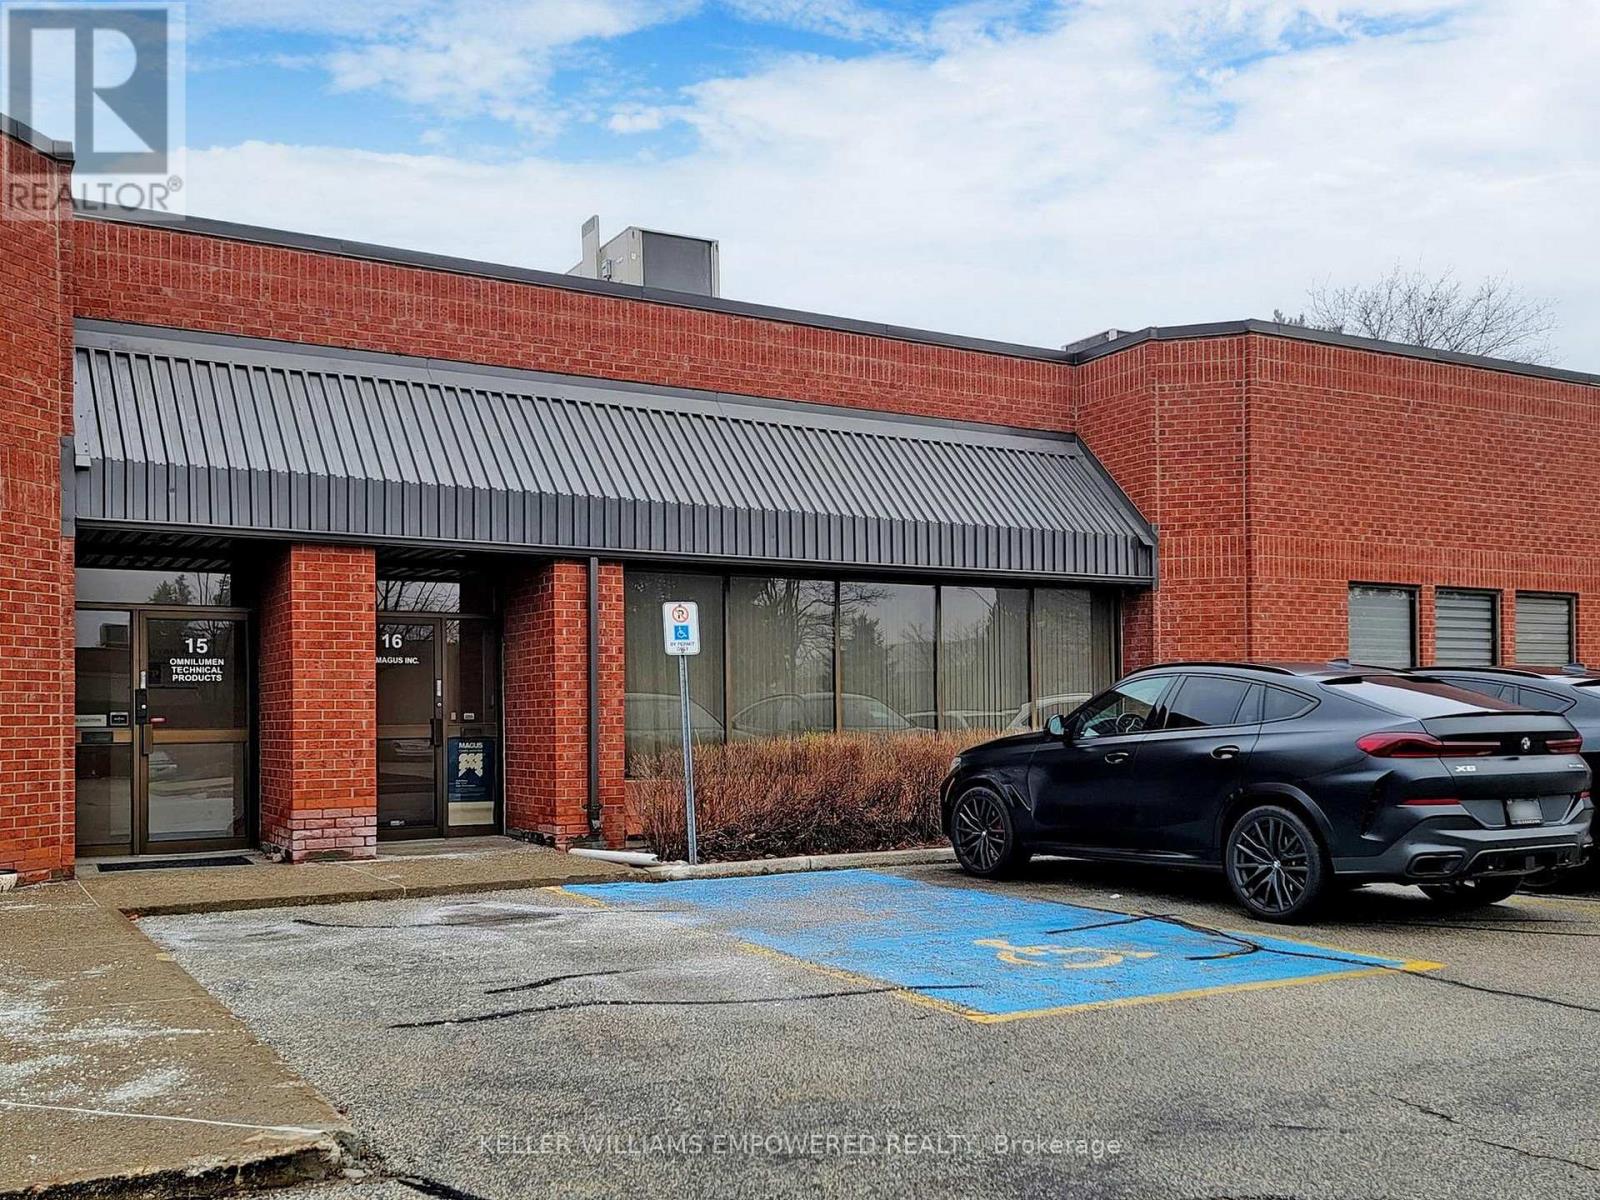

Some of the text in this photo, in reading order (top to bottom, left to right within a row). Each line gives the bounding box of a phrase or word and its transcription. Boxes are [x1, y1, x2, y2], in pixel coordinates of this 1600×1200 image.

[382, 633, 402, 648] 16
[185, 638, 208, 653] 15
[375, 656, 403, 664] MAGUS
[171, 666, 223, 674] TECHNICAL
[172, 674, 222, 682] PRODUCTS
